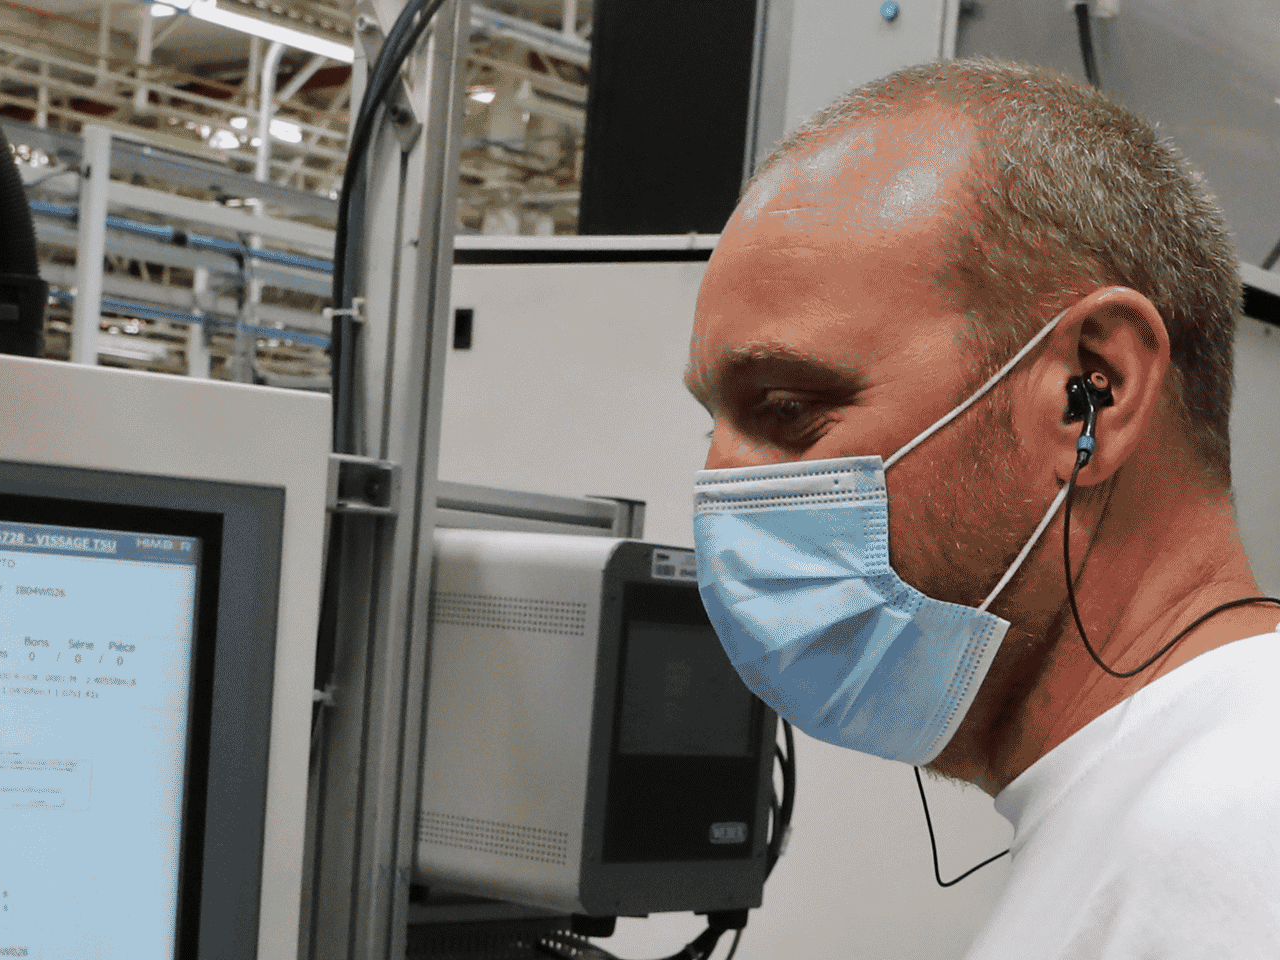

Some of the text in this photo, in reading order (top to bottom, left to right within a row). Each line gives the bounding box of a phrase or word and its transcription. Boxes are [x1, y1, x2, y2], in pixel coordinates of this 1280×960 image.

[36, 534, 89, 550] VISSAGE
[24, 636, 50, 648] Bons
[28, 651, 35, 661] 0
[74, 653, 81, 664] 0
[116, 655, 124, 666] 0
